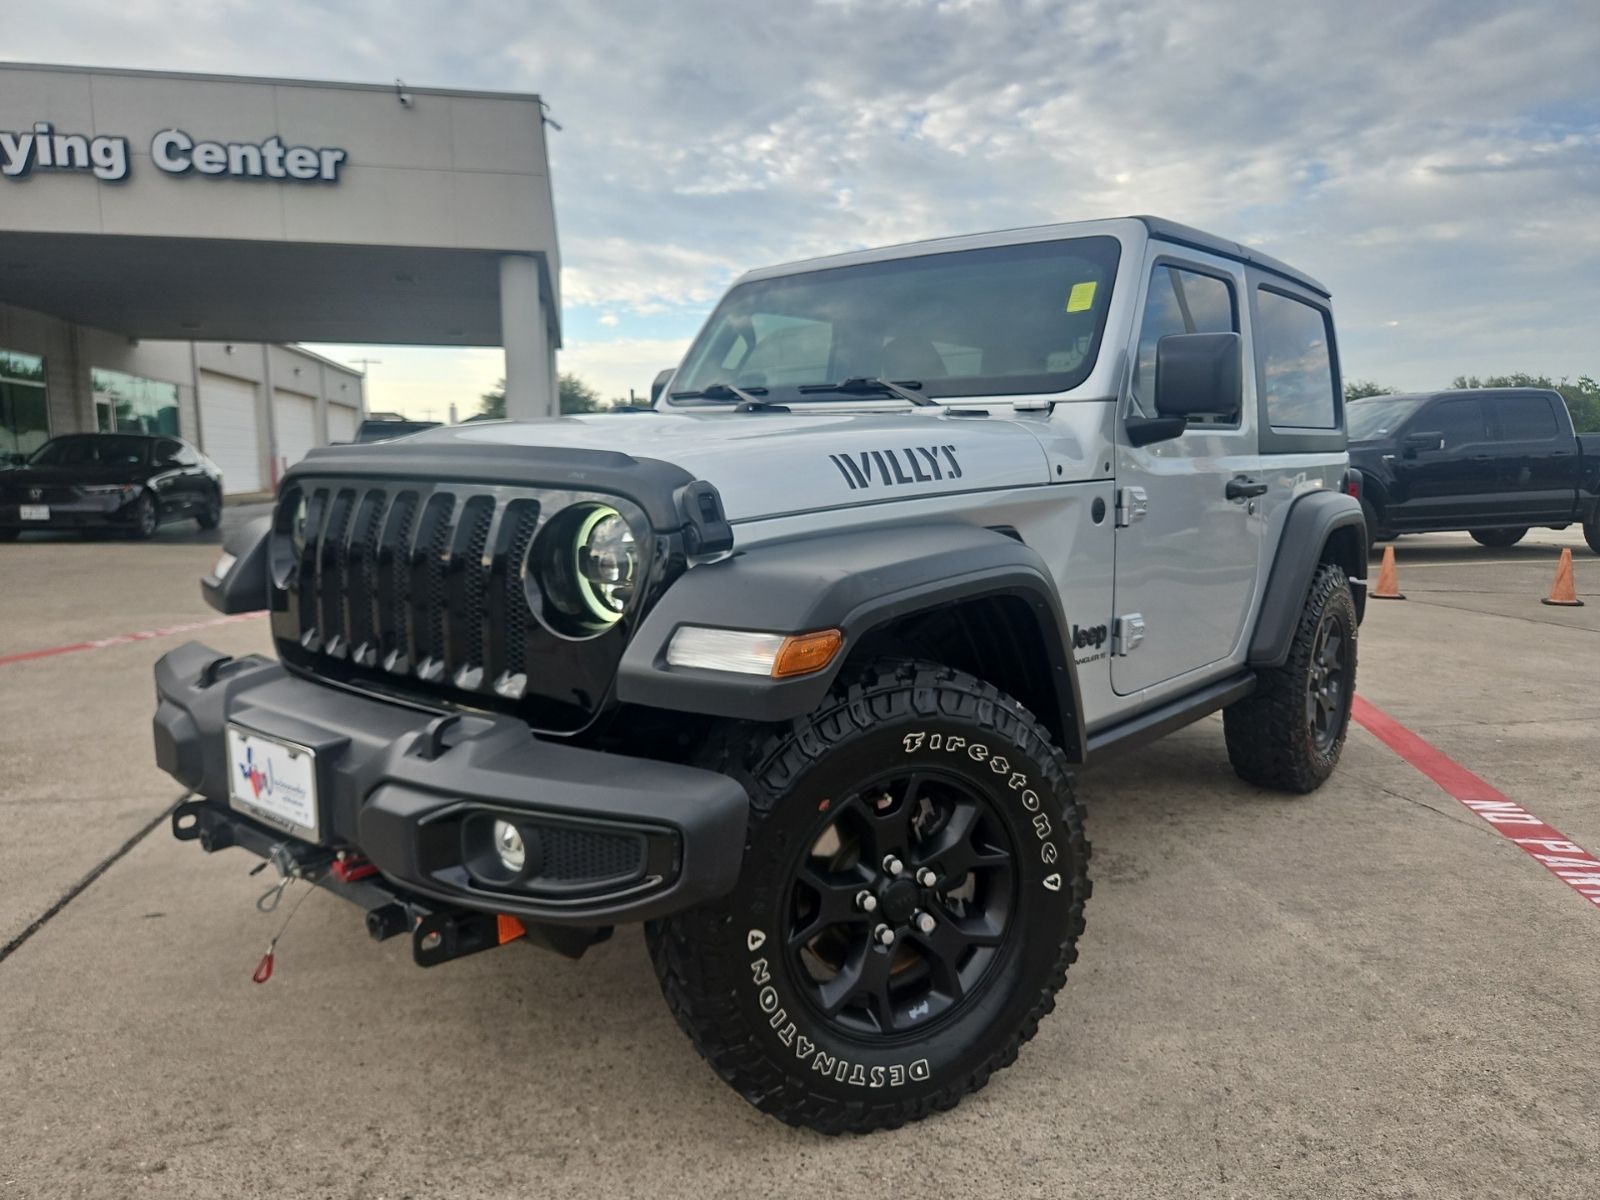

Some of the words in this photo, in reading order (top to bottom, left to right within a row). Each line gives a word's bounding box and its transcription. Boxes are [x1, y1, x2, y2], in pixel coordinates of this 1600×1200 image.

[0, 122, 127, 180] ying
[152, 129, 345, 181] Center
[828, 445, 962, 489] WILLYS
[903, 732, 1058, 864] Firestone
[1461, 799, 1544, 825] NO
[751, 958, 930, 1088] DESTINATION
